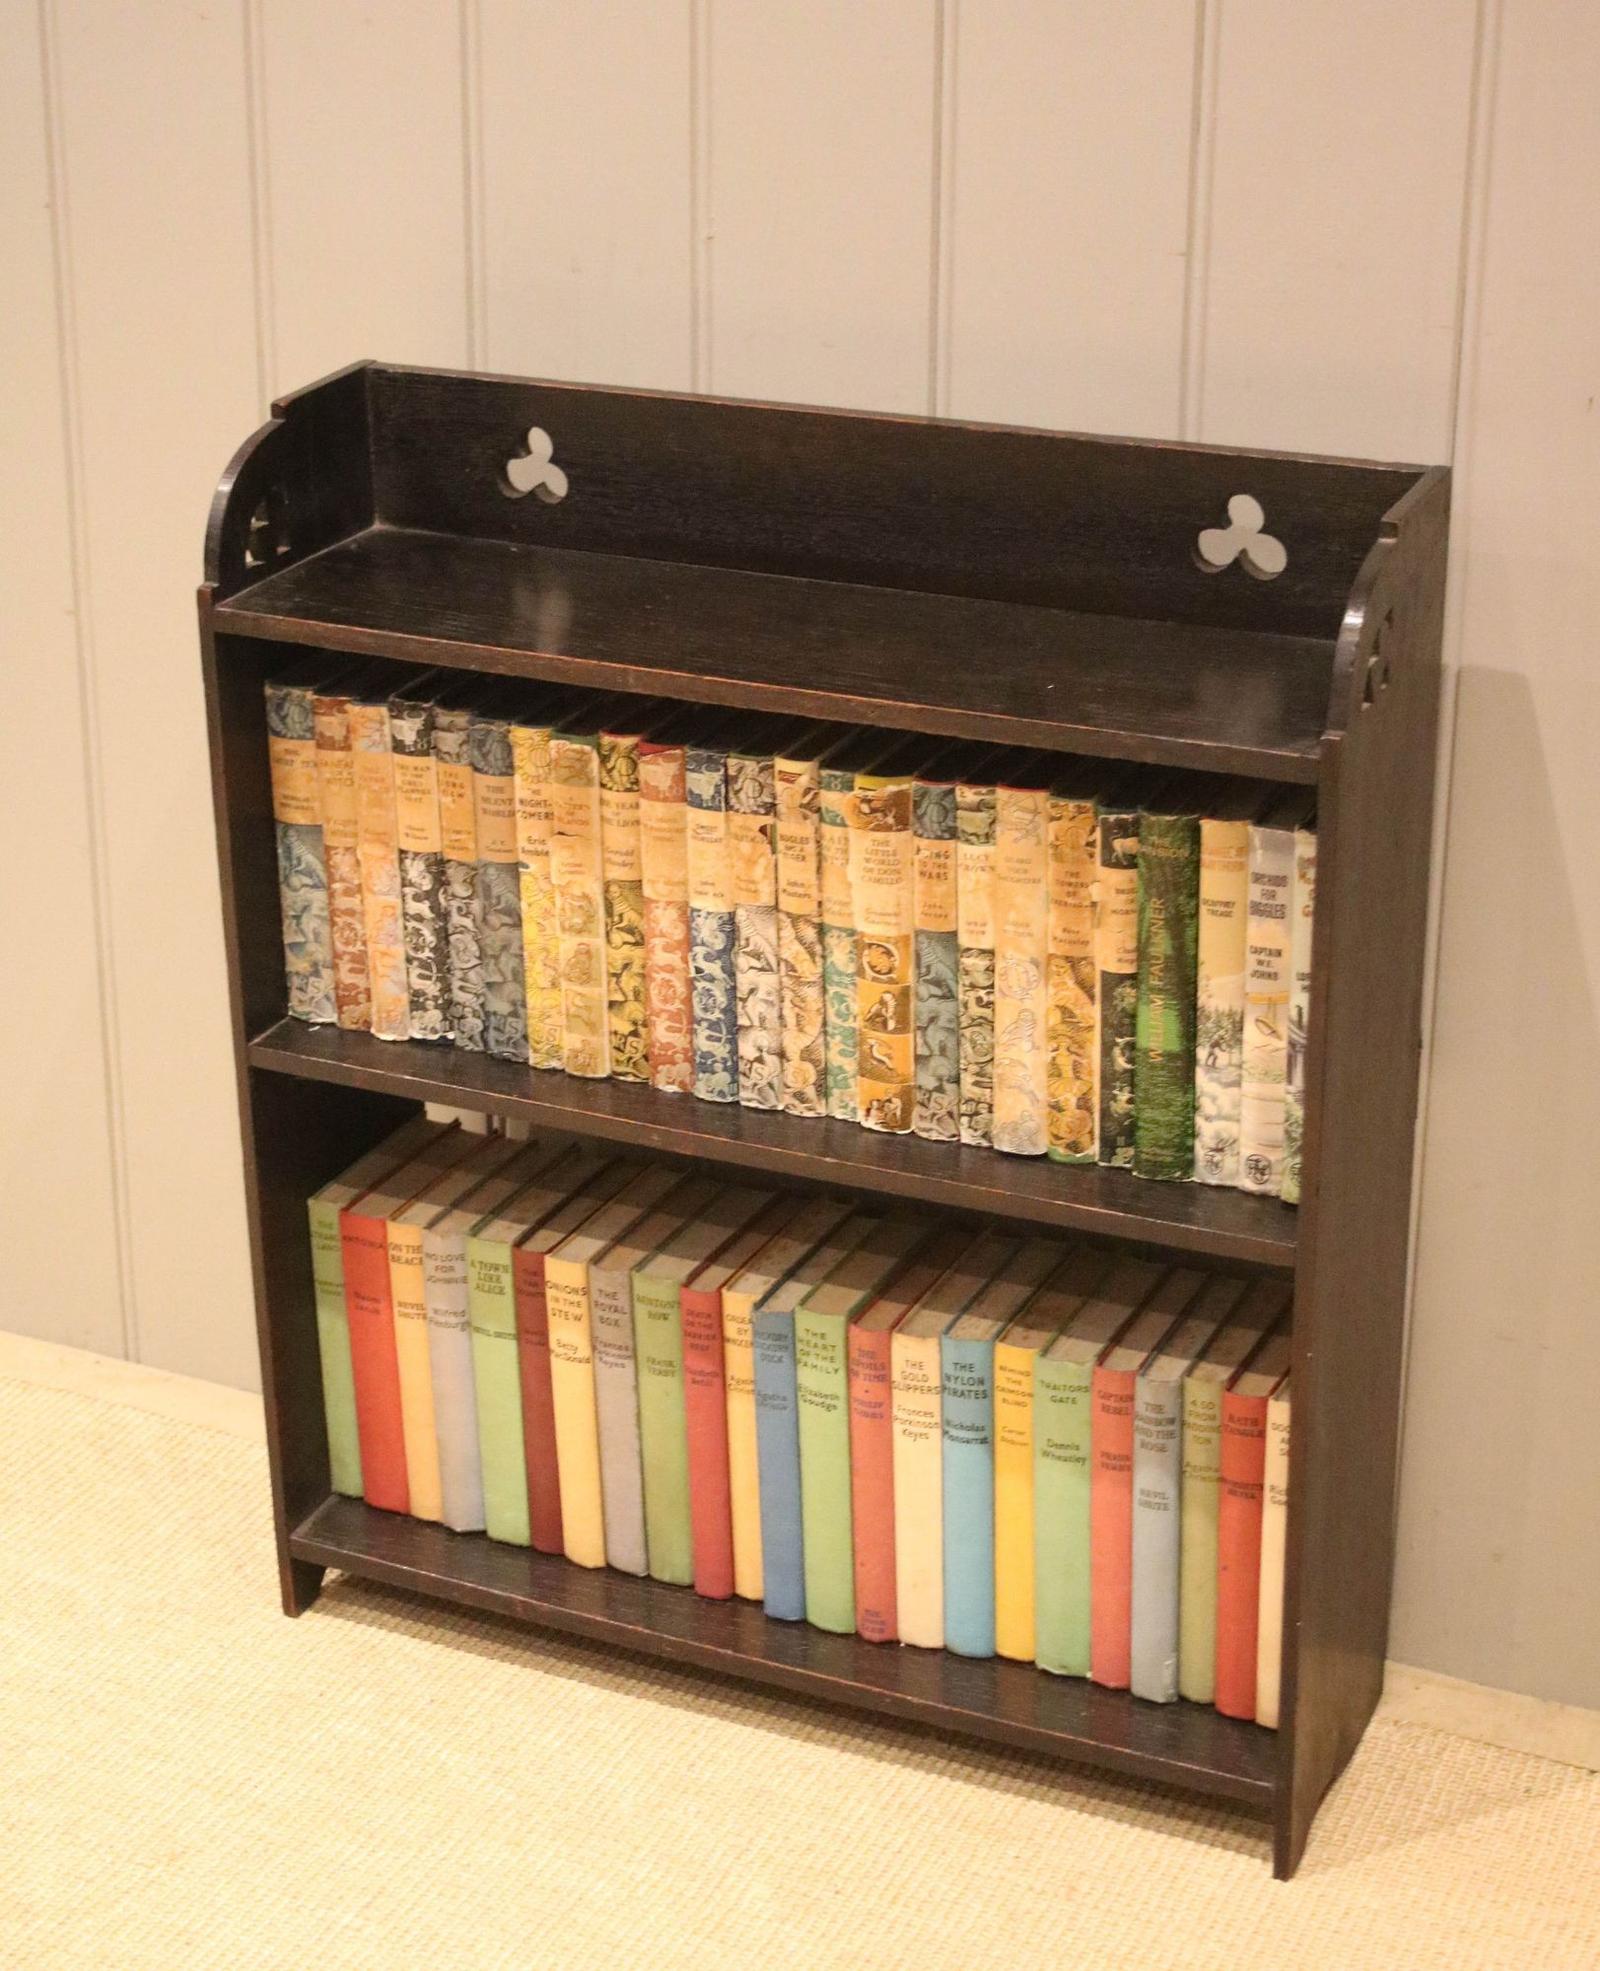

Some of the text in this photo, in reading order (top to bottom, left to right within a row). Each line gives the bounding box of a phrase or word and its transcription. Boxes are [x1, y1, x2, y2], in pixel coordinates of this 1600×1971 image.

[527, 835, 547, 846] Eric
[871, 839, 890, 848] THE
[864, 848, 897, 857] LITTLE
[863, 857, 901, 867] WORLD
[919, 870, 949, 881] WARS
[1065, 870, 1080, 878] THE
[1251, 871, 1288, 887] ORCHIDS
[1260, 889, 1277, 901] FOR
[1249, 900, 1287, 919] BIGGLES
[1249, 945, 1282, 957] CAPTAIN
[1149, 898, 1165, 1062] WILLIAM FAULKNER
[1250, 969, 1278, 981] JOHNS
[389, 1243, 423, 1254] ON THE
[441, 1253, 465, 1262] LOVE
[434, 1264, 456, 1273] FOR
[478, 1261, 510, 1273] TOWN
[477, 1272, 502, 1284] LIKE
[474, 1283, 506, 1296] ALICE
[545, 1280, 588, 1296] ONIONS
[597, 1289, 619, 1301] THE
[398, 1300, 425, 1311] NEVIL
[563, 1298, 582, 1309] THE
[594, 1300, 628, 1315] ROYAL
[551, 1308, 583, 1322] STEW
[599, 1315, 621, 1328] BOX
[737, 1327, 748, 1336] BY
[804, 1328, 827, 1340] THE
[797, 1338, 838, 1351] HEART
[799, 1348, 836, 1364] OF THE
[797, 1358, 840, 1375] FAMILY
[905, 1359, 924, 1371] THE
[952, 1362, 975, 1373] THE
[998, 1364, 1032, 1377] BEHIND
[861, 1373, 887, 1384] TIME
[900, 1370, 929, 1383] GOLD
[944, 1373, 985, 1387] NYLON
[1006, 1376, 1023, 1386] THE
[891, 1380, 941, 1395] SLIPPERS
[942, 1384, 988, 1400] PIRATES
[995, 1384, 1035, 1398] CRIMSON
[1039, 1379, 1090, 1393] TRAITORS
[1001, 1397, 1028, 1408] BLIND
[1049, 1394, 1078, 1405] GATE
[896, 1405, 935, 1418] Frances
[1100, 1403, 1130, 1416] REBEL
[1143, 1401, 1166, 1415] THE
[893, 1415, 941, 1429] Parkinson
[944, 1418, 986, 1432] Nicholas
[902, 1428, 930, 1442] Keyes
[1155, 1428, 1177, 1440] THE
[1046, 1438, 1081, 1451] Dennis
[1139, 1438, 1168, 1453] ROSE
[1041, 1449, 1088, 1466] Wheatley
